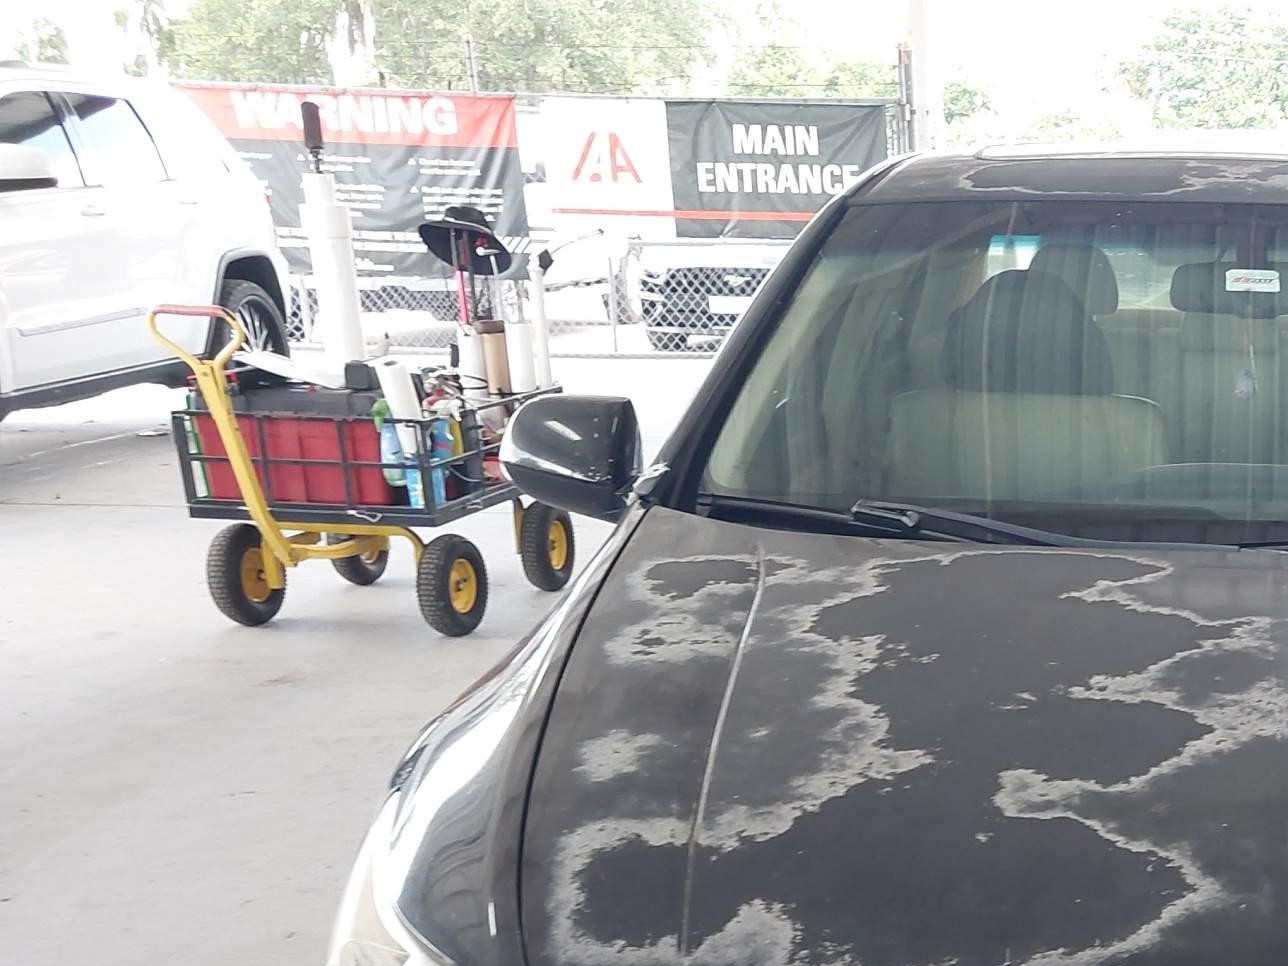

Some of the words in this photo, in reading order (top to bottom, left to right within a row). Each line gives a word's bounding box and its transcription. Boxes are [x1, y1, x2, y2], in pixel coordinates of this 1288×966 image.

[229, 91, 458, 135] WARNING
[732, 123, 819, 156] MAIN
[696, 160, 861, 195] ENTRANCE
